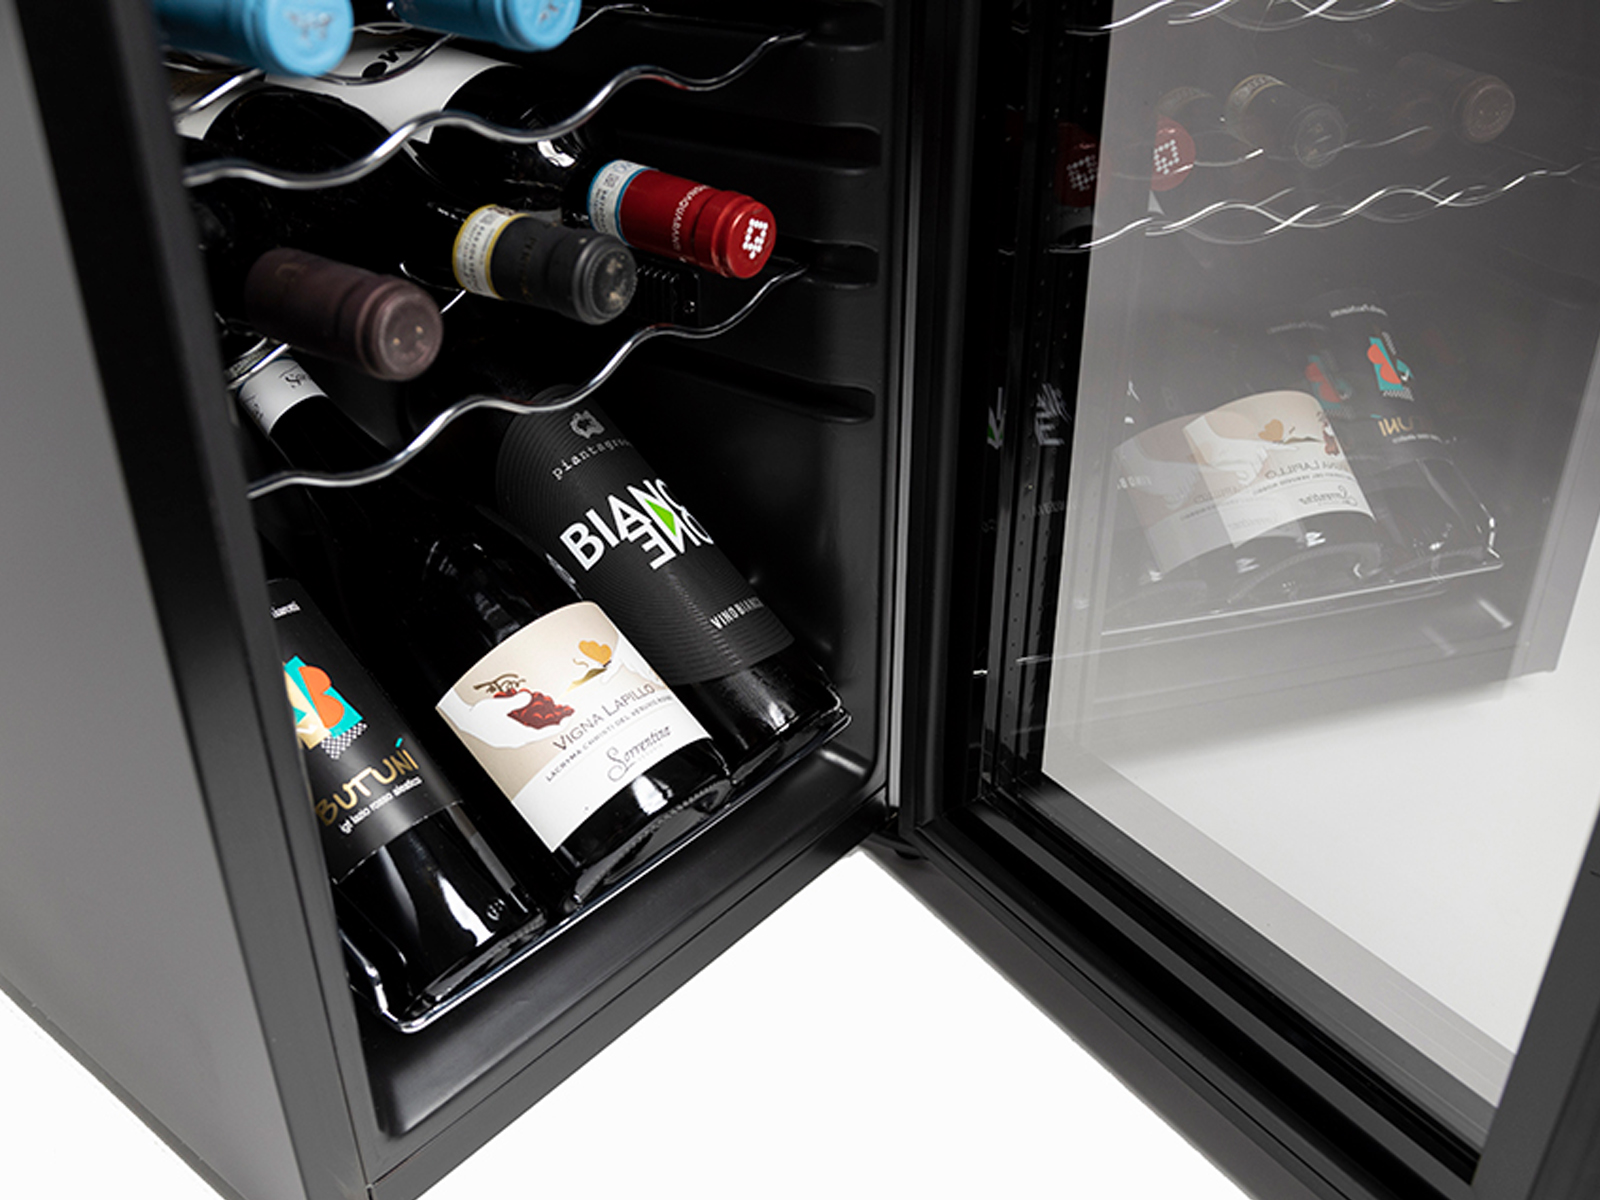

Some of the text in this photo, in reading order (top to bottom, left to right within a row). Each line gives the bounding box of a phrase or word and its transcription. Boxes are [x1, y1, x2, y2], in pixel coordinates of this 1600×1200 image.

[710, 605, 739, 629] VINO
[552, 684, 656, 751] VIGNA LAPILLO
[614, 715, 631, 727] DEL
[607, 724, 672, 782] Sorrentino
[338, 818, 354, 835] igt
